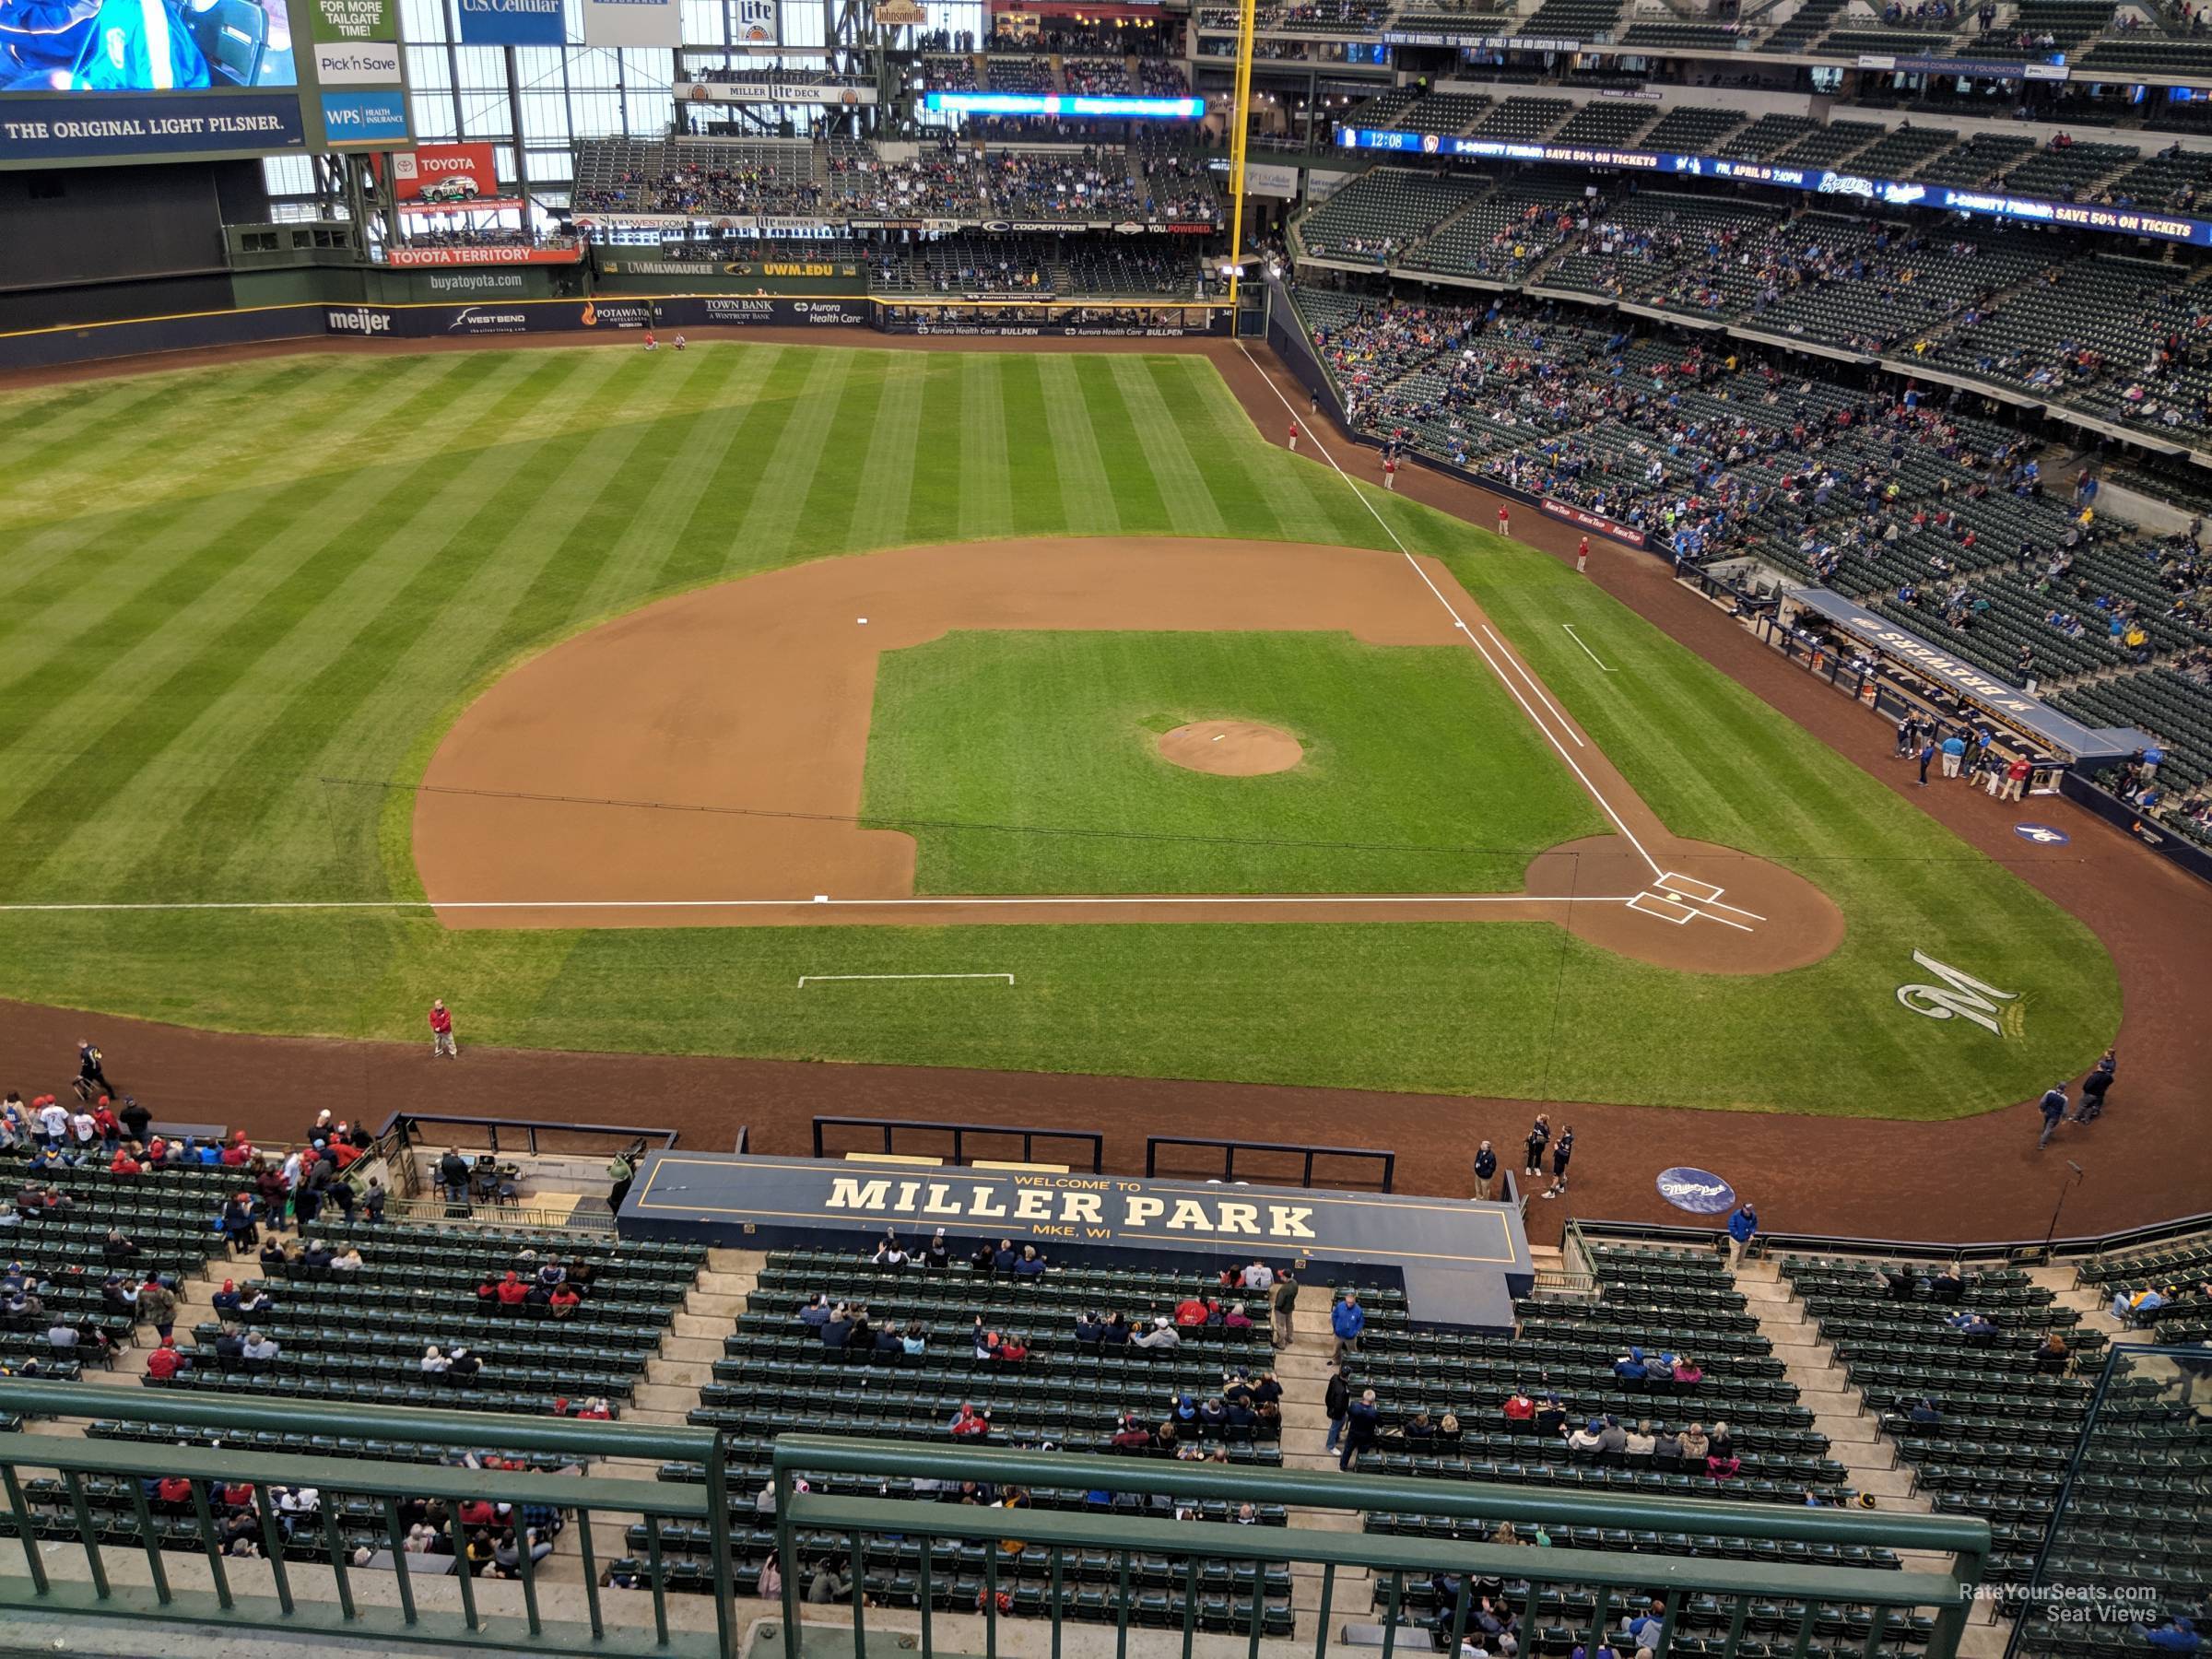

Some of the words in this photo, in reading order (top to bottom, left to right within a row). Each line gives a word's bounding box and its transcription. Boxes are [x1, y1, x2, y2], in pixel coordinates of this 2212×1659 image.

[320, 1, 345, 12] FOR
[347, 1, 382, 13] MORE
[325, 13, 381, 25] TAILGATE
[877, 8, 925, 23] Johnsonville
[339, 25, 371, 36] TIME!
[363, 57, 395, 70] Save
[730, 88, 766, 97] MILLER
[794, 89, 820, 98] DECK
[326, 110, 360, 124] WPS
[5, 123, 48, 139] THE
[53, 120, 146, 138] ORIGINAL
[148, 117, 205, 135] LIGHT
[209, 115, 284, 133] PILSNER.
[1371, 133, 1402, 148] 12:08
[1545, 148, 1571, 160] SAVE
[1573, 151, 1594, 162] 50%
[1612, 154, 1657, 167] TICKETS
[421, 158, 476, 171] TOYOTA
[1733, 165, 1760, 178] APRIL
[2055, 208, 2089, 223] SAVE
[2090, 212, 2117, 227] 50%
[2119, 217, 2138, 230] ON
[2140, 218, 2192, 237] TICKETS
[392, 251, 452, 265] TOYOTA
[453, 249, 531, 262] TERRITORY
[764, 264, 833, 276] UWM.EDU
[430, 275, 523, 291] buyatoyota.com
[705, 300, 739, 310] TOWN
[743, 300, 774, 312] BANK
[810, 302, 841, 312] Aurora
[329, 308, 391, 335] meijer
[466, 316, 497, 324] WEST
[809, 313, 839, 324] Health
[841, 314, 862, 324] Care
[931, 326, 954, 335] Aurora
[956, 326, 979, 335] Health
[1104, 328, 1125, 336] Health
[1877, 632, 2007, 696] BREWERS
[1014, 1175, 1112, 1190] WELCOME
[1116, 1182, 1142, 1193] TO
[826, 1178, 1104, 1224] MILLER
[1124, 1194, 1316, 1239] PARK
[1032, 1224, 1079, 1239] MKE,
[1086, 1227, 1112, 1240] WI
